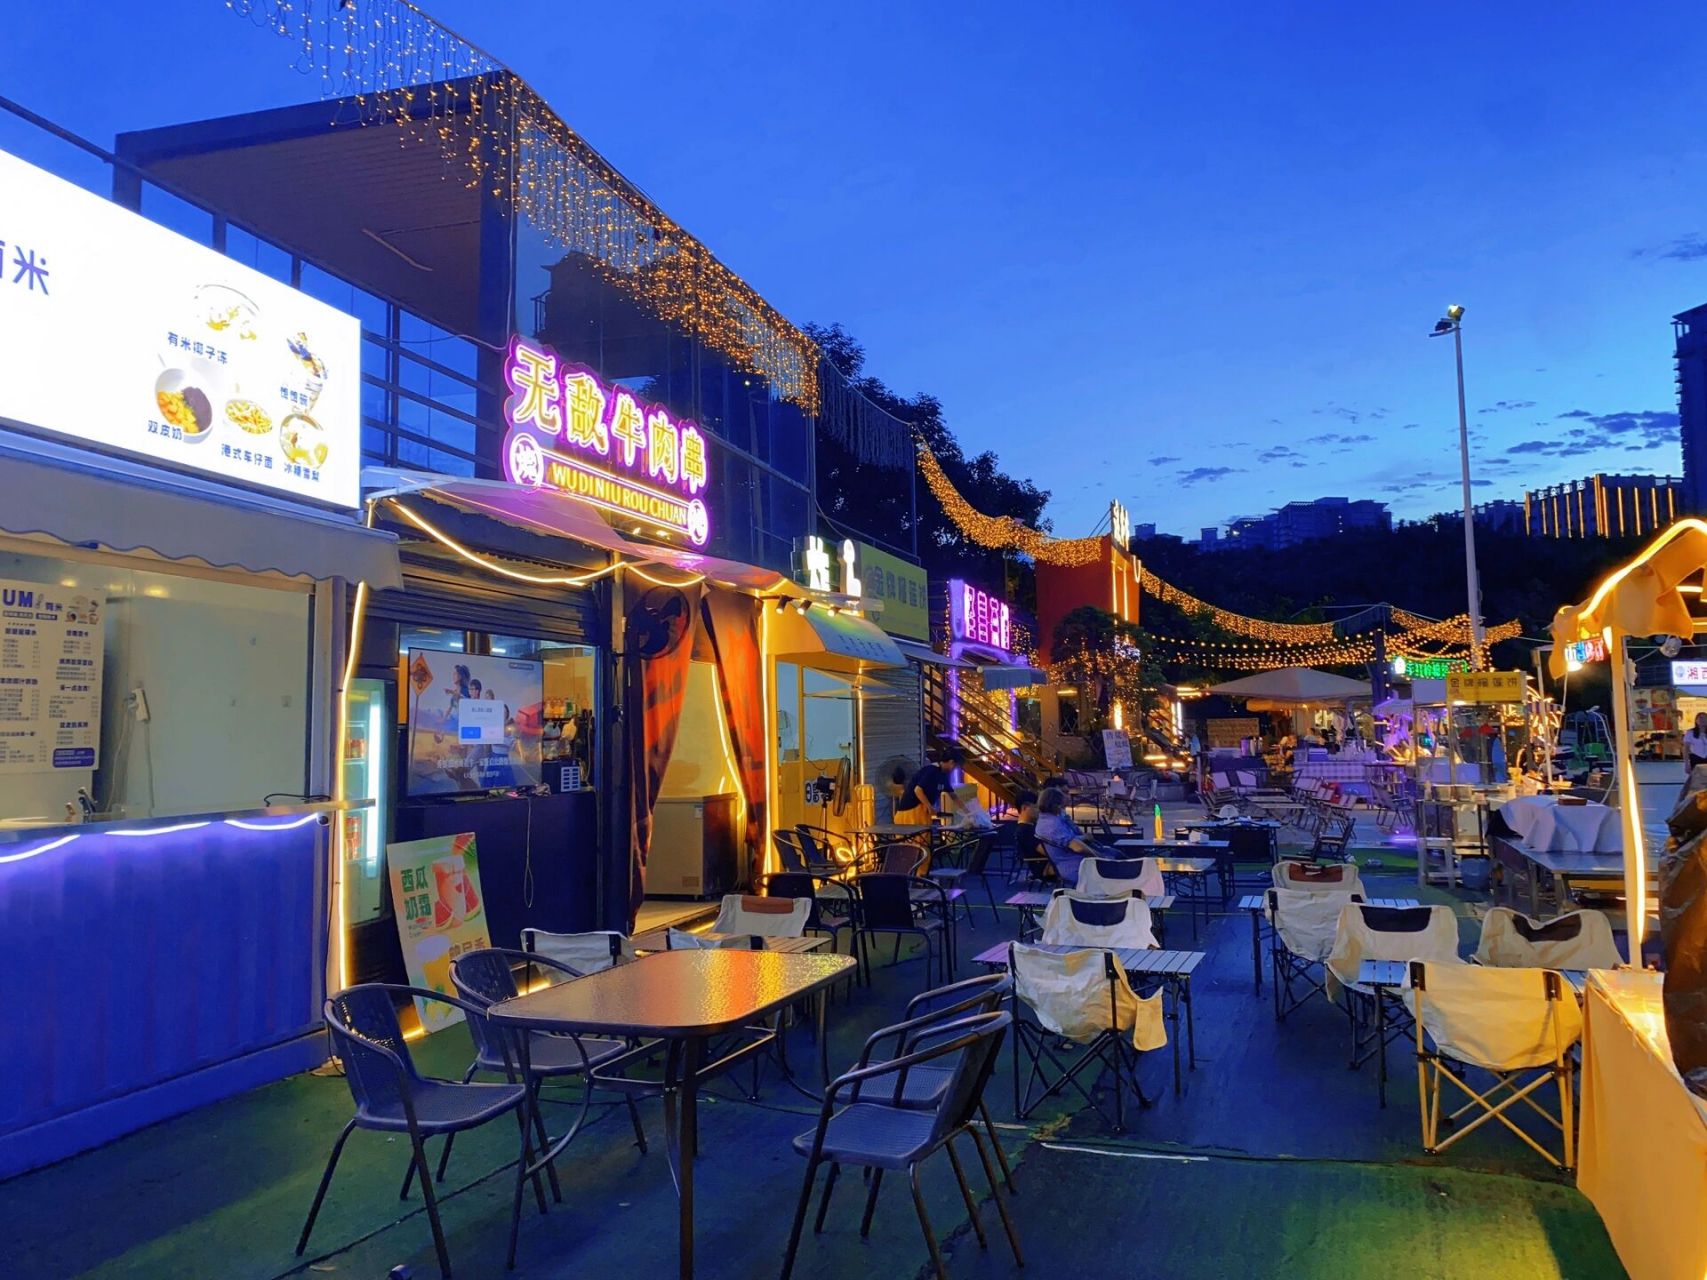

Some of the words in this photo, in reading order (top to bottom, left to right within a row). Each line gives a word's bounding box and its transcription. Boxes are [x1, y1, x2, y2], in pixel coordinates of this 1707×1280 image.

[0, 241, 50, 296] 米
[147, 419, 183, 441] 双皮奶
[511, 344, 707, 495] 无敌牛肉串
[221, 443, 273, 469] 港式车仔面
[401, 865, 428, 893] 西瓜
